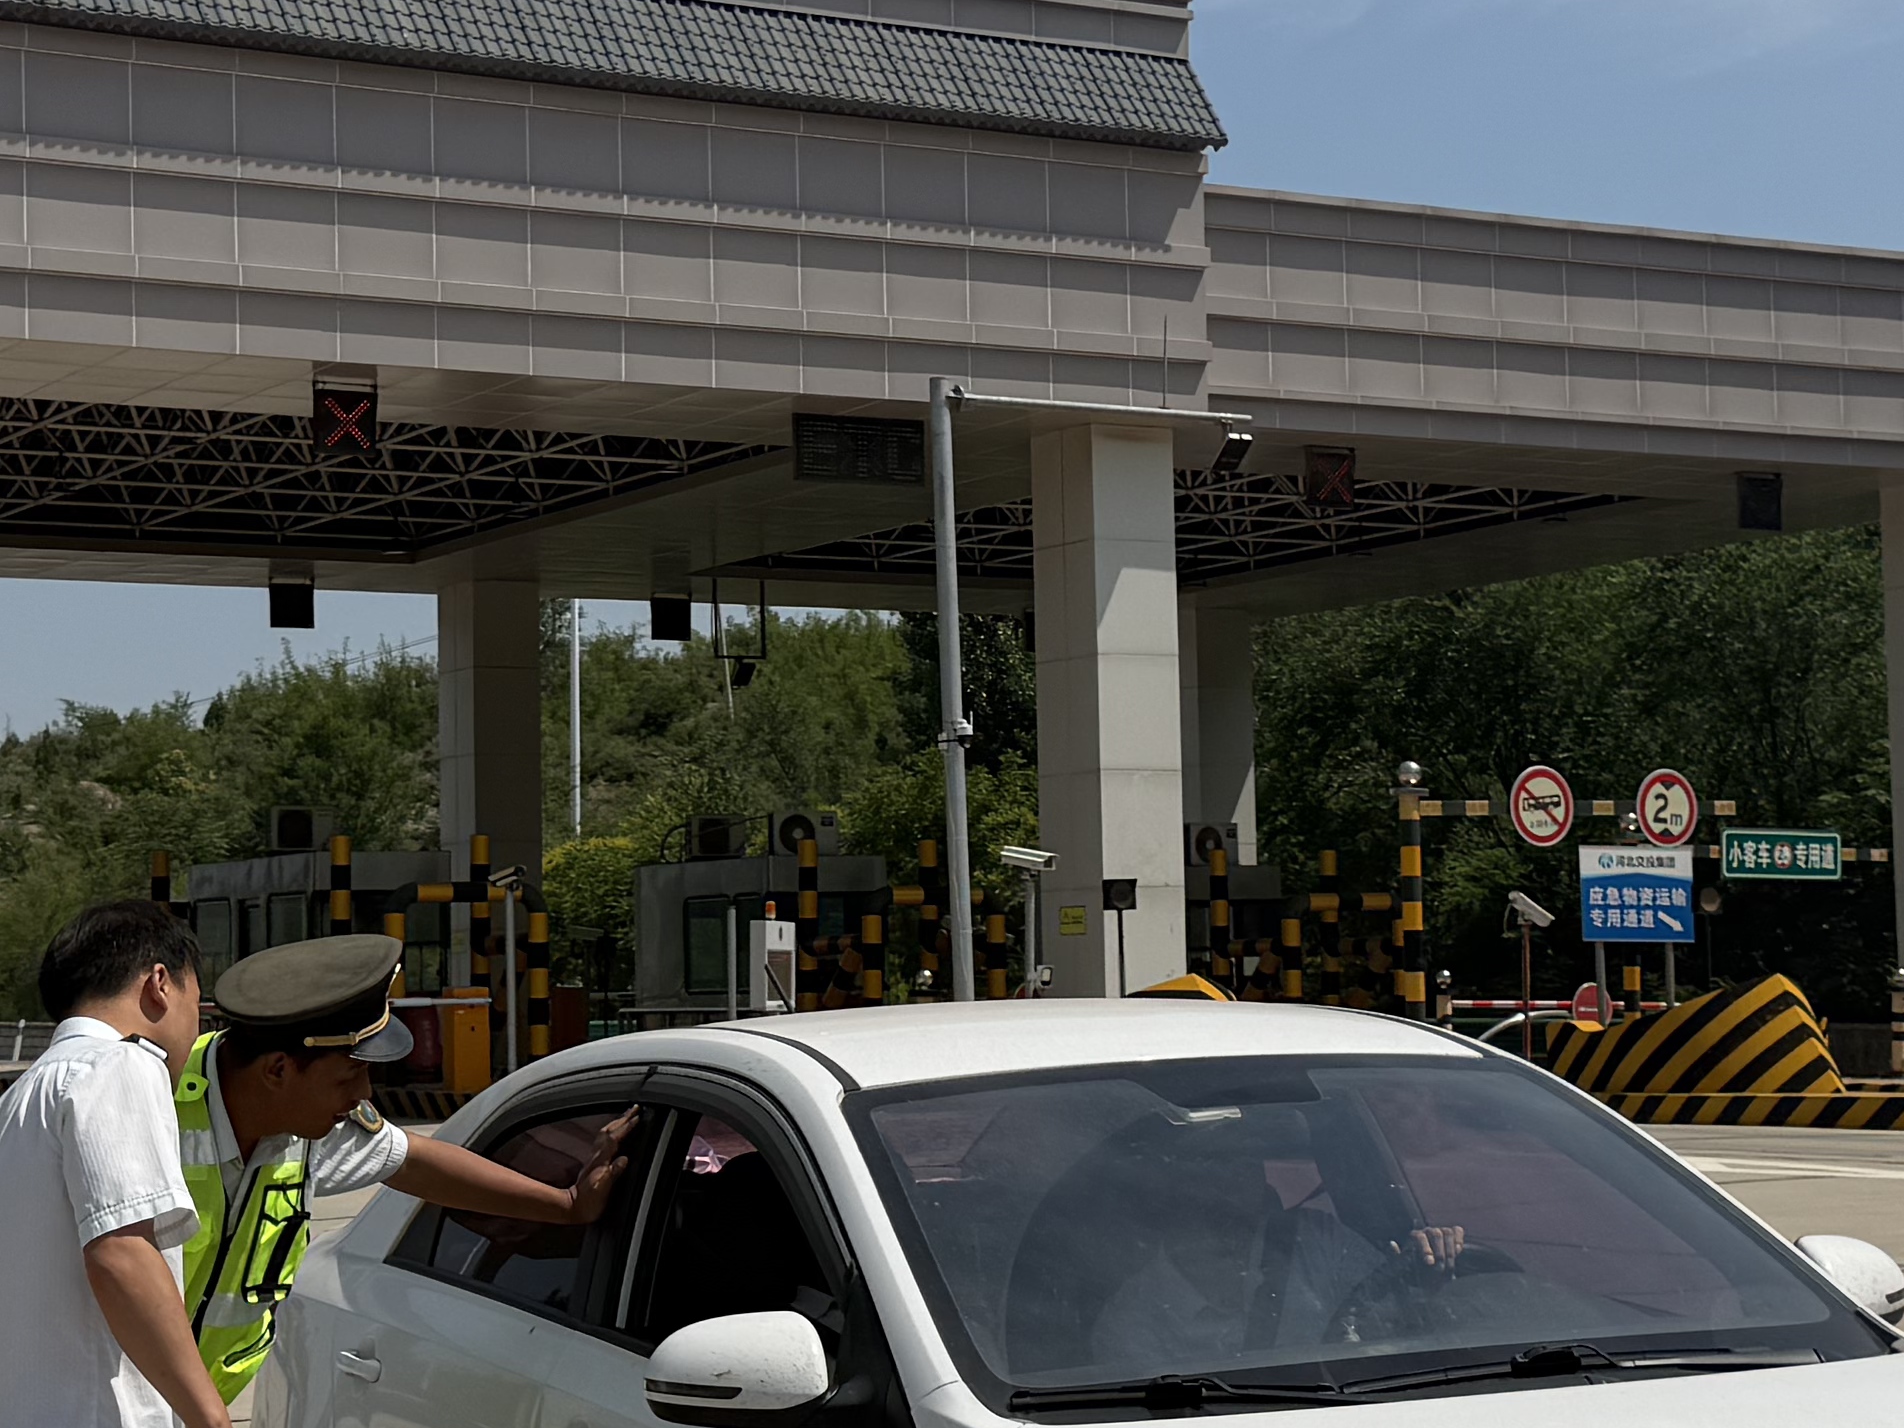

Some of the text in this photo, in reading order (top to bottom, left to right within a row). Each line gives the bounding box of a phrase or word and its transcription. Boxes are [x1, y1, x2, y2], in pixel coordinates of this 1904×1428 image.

[1729, 840, 1772, 869] 小客车
[1794, 841, 1836, 870] 专用道
[1589, 886, 1687, 907] 应急物资运输
[1589, 908, 1655, 928] 专用通道
